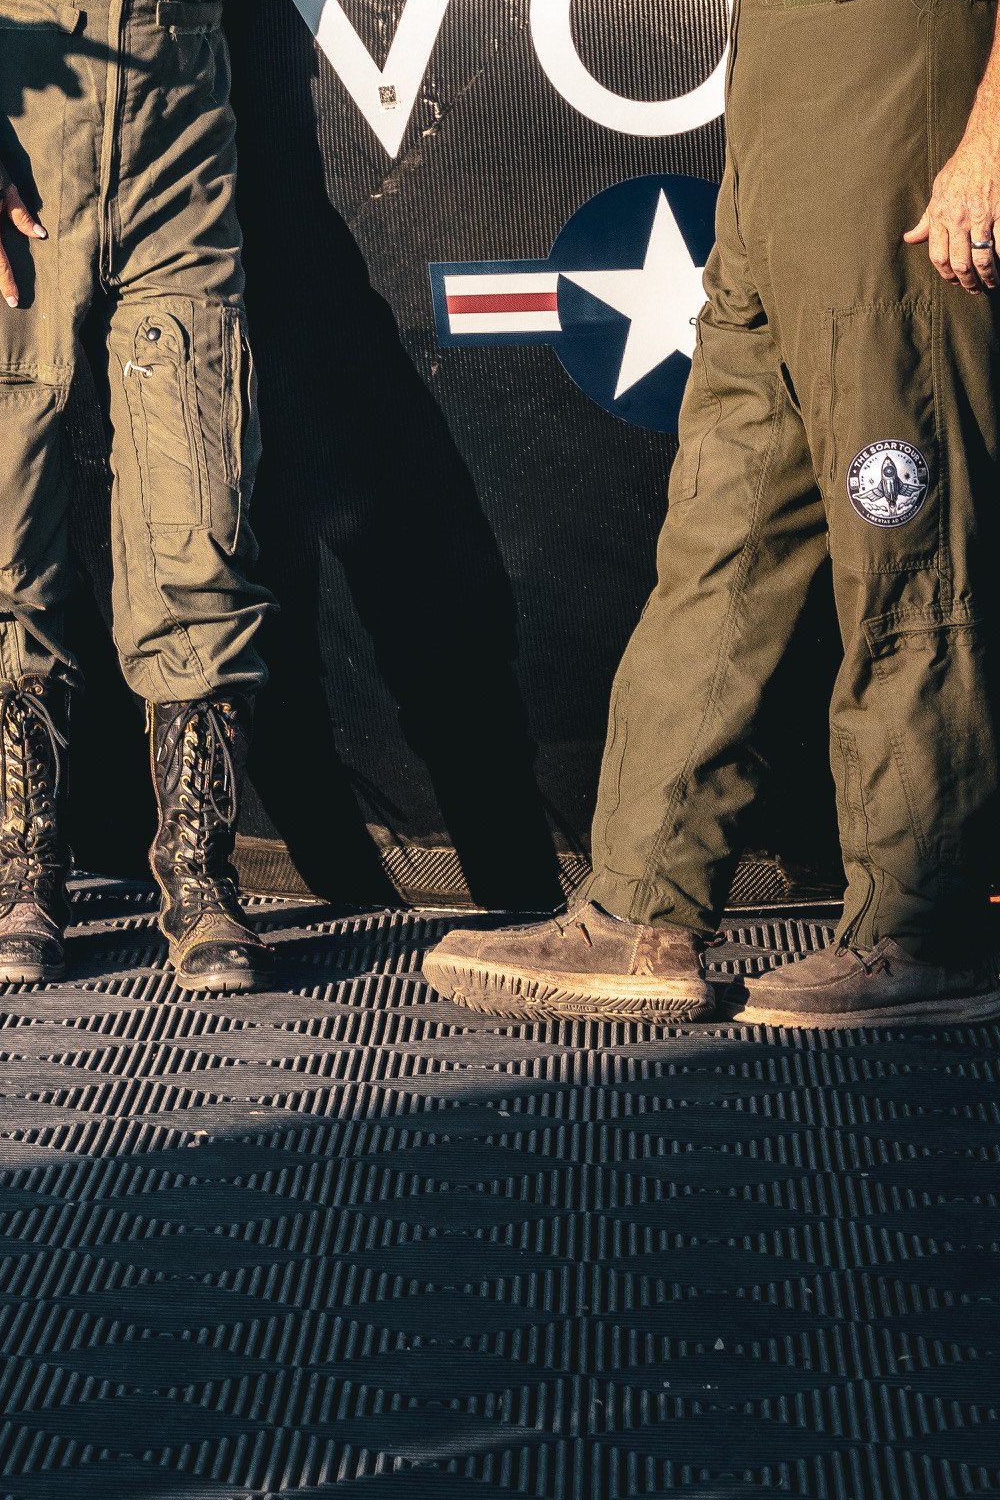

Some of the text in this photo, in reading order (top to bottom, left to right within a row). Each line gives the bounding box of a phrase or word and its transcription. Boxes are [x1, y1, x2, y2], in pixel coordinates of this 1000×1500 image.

[854, 443, 920, 468] THE SOAR TOUR
